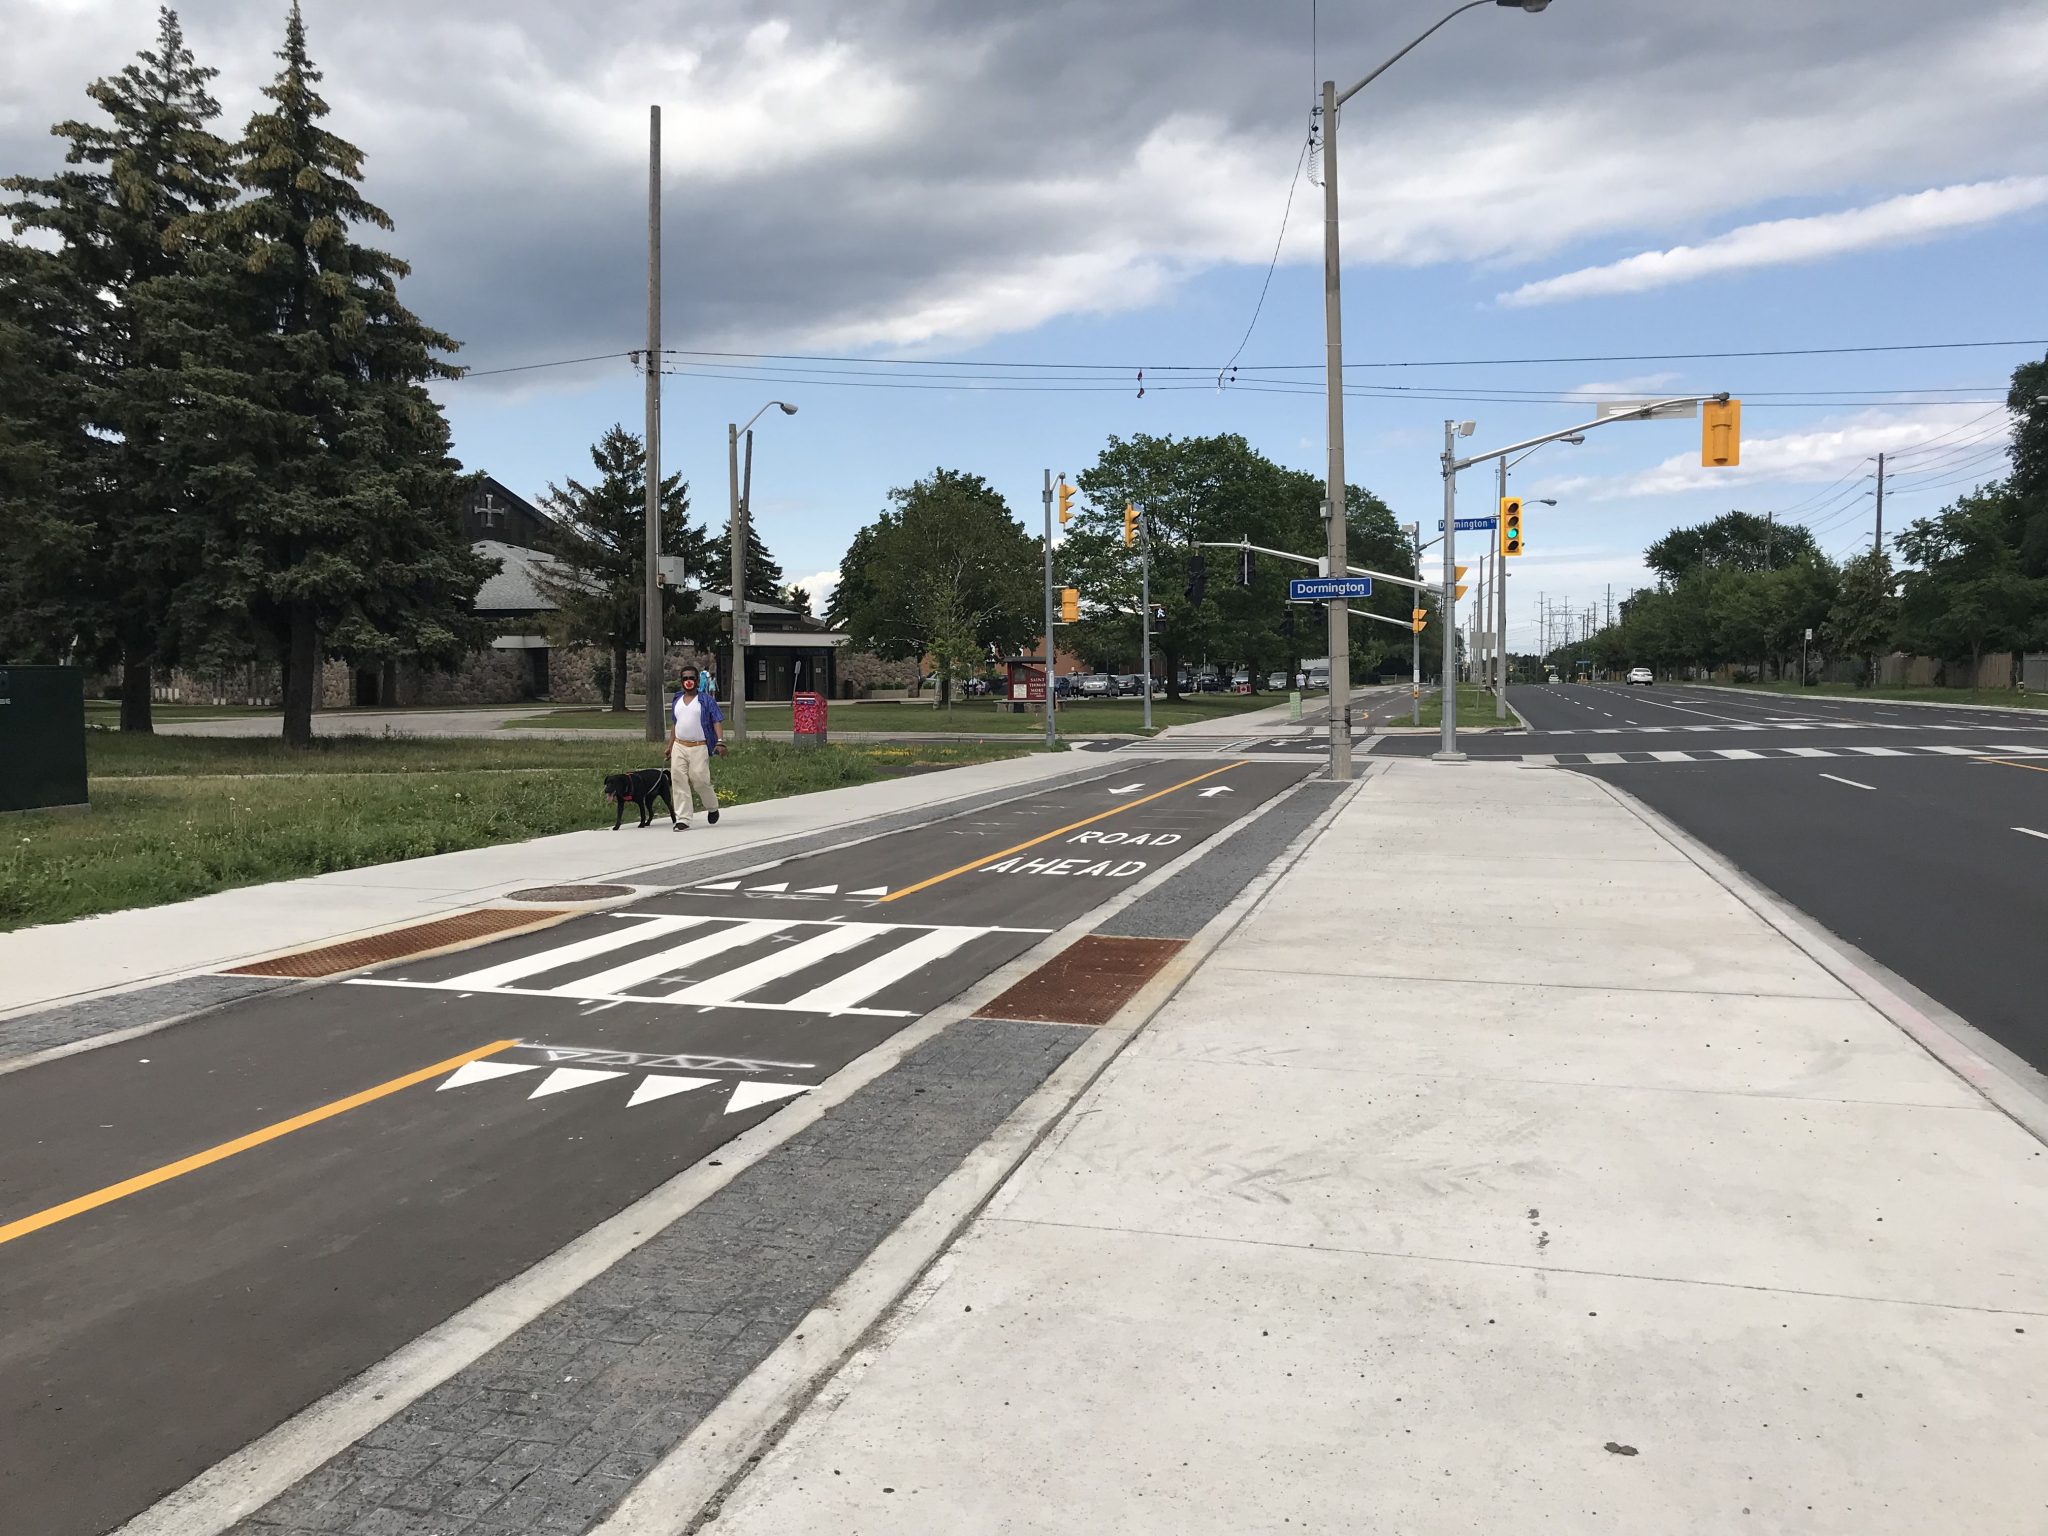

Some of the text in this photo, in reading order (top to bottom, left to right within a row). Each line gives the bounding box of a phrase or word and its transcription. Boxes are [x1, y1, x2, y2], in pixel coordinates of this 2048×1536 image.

[1439, 519, 1488, 530] Dmington
[1297, 582, 1365, 595] Dormington
[1066, 831, 1182, 846] ROAD
[978, 857, 1147, 877] AHEAD
